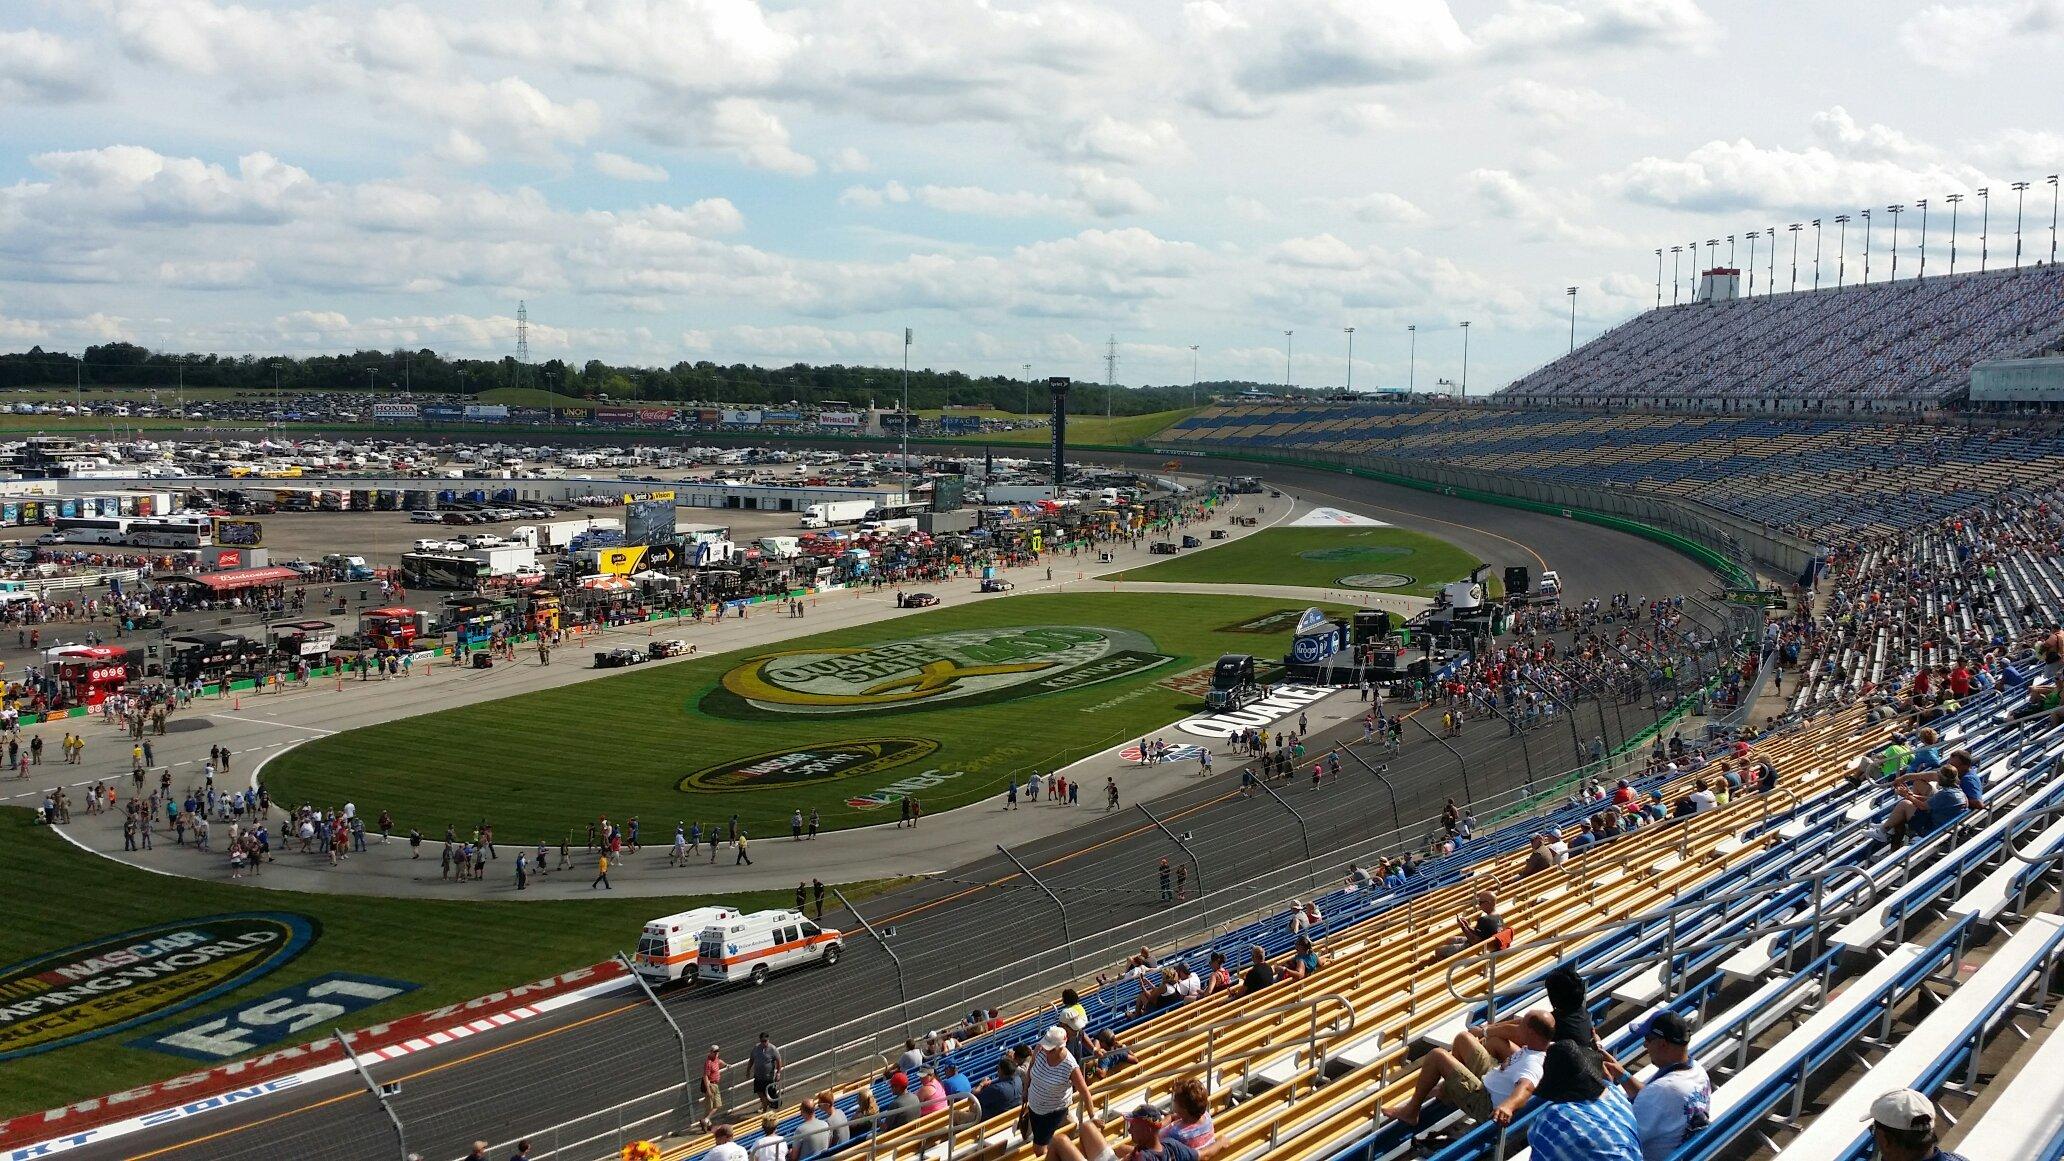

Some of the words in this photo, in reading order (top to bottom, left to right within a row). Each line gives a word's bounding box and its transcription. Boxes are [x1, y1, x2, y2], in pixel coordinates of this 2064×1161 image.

[562, 408, 588, 416] UNOH
[821, 415, 855, 424] WHELEN
[634, 492, 648, 500] Sprint
[651, 553, 668, 562] Sprint
[769, 643, 922, 683] QUAKER
[1296, 642, 1317, 659] Kroger
[846, 652, 950, 684] STATE
[1040, 656, 1146, 688] KENTUCKY
[737, 753, 820, 777] NASCAR
[783, 752, 863, 775] Sprint
[884, 768, 964, 797] NBC
[55, 931, 208, 980] NASCAR
[117, 931, 279, 978] WORLD
[421, 965, 596, 1023] ZONE
[155, 979, 405, 1057] FS1
[139, 1074, 304, 1127] ZONE
